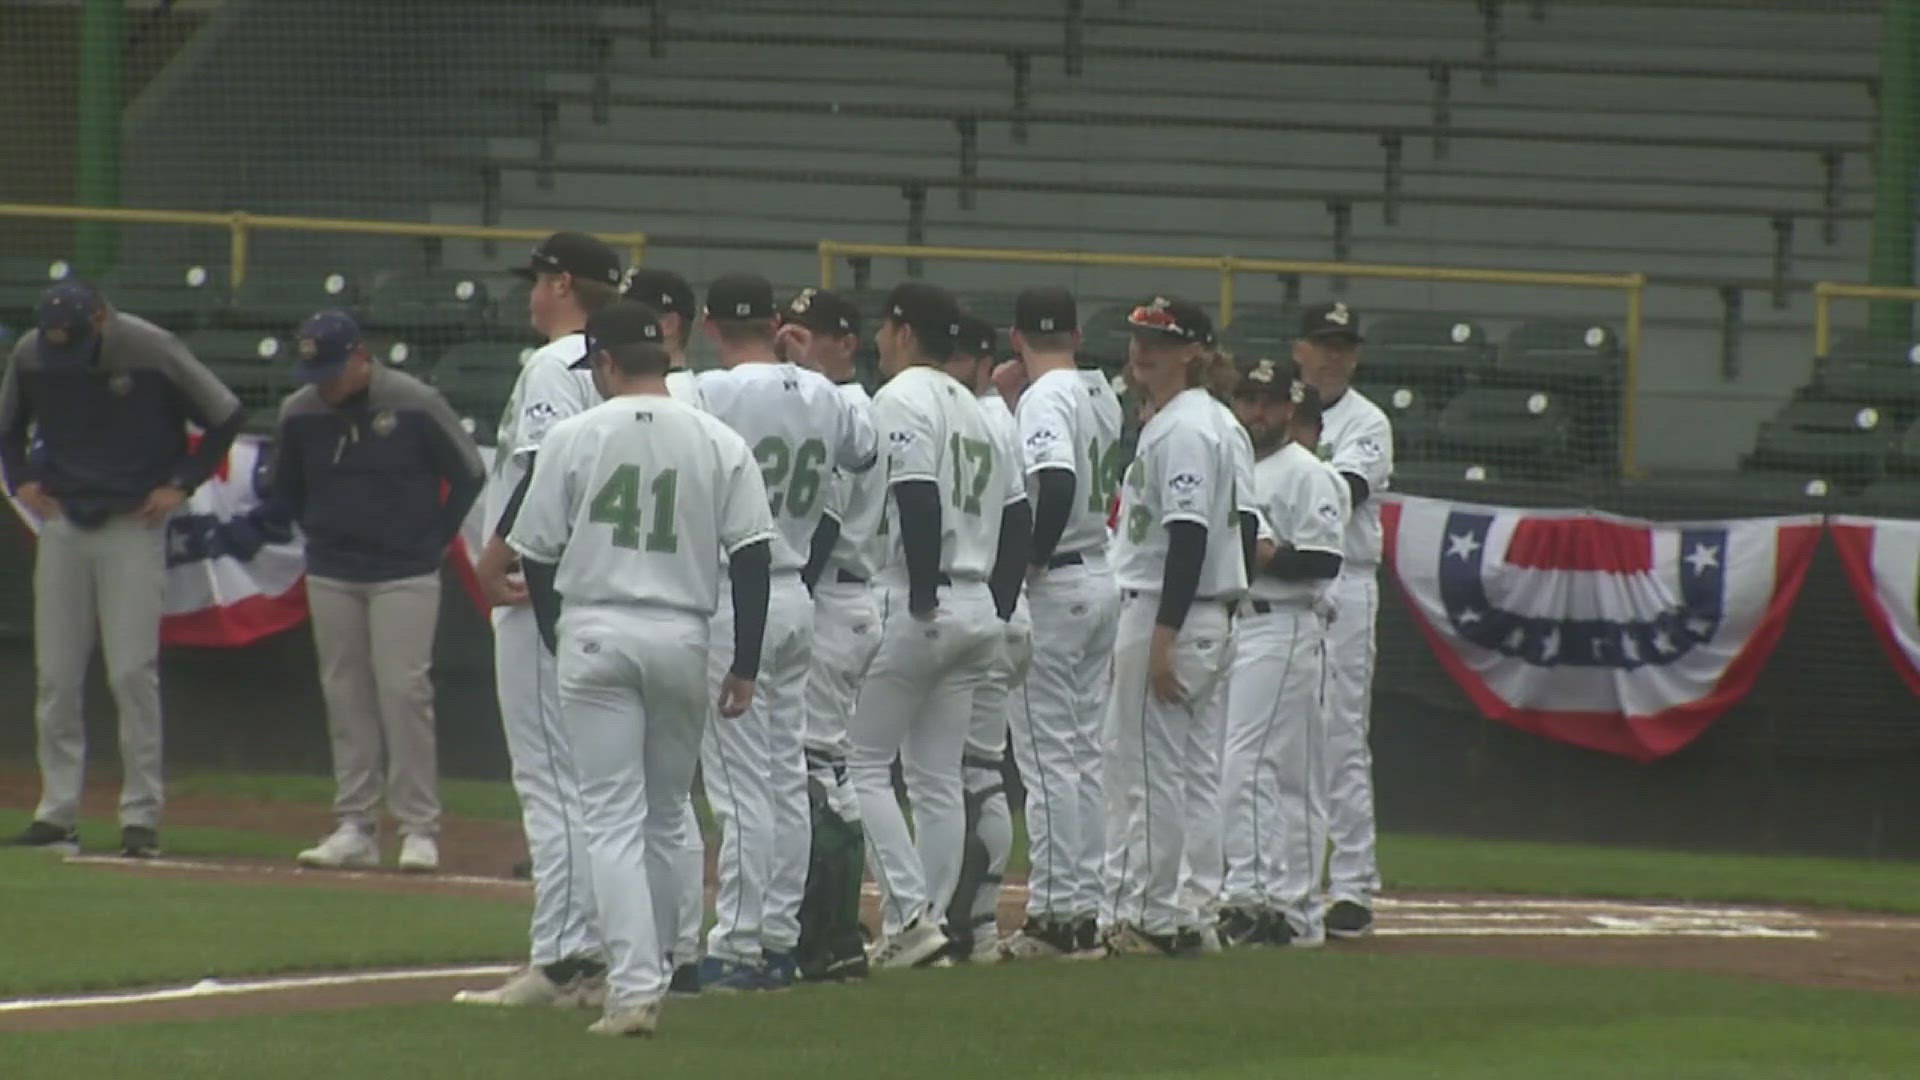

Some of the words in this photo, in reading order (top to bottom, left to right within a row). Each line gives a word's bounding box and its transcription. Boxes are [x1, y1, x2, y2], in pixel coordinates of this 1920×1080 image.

[589, 463, 678, 554] 41
[753, 435, 827, 519] 26
[950, 432, 992, 517] 17
